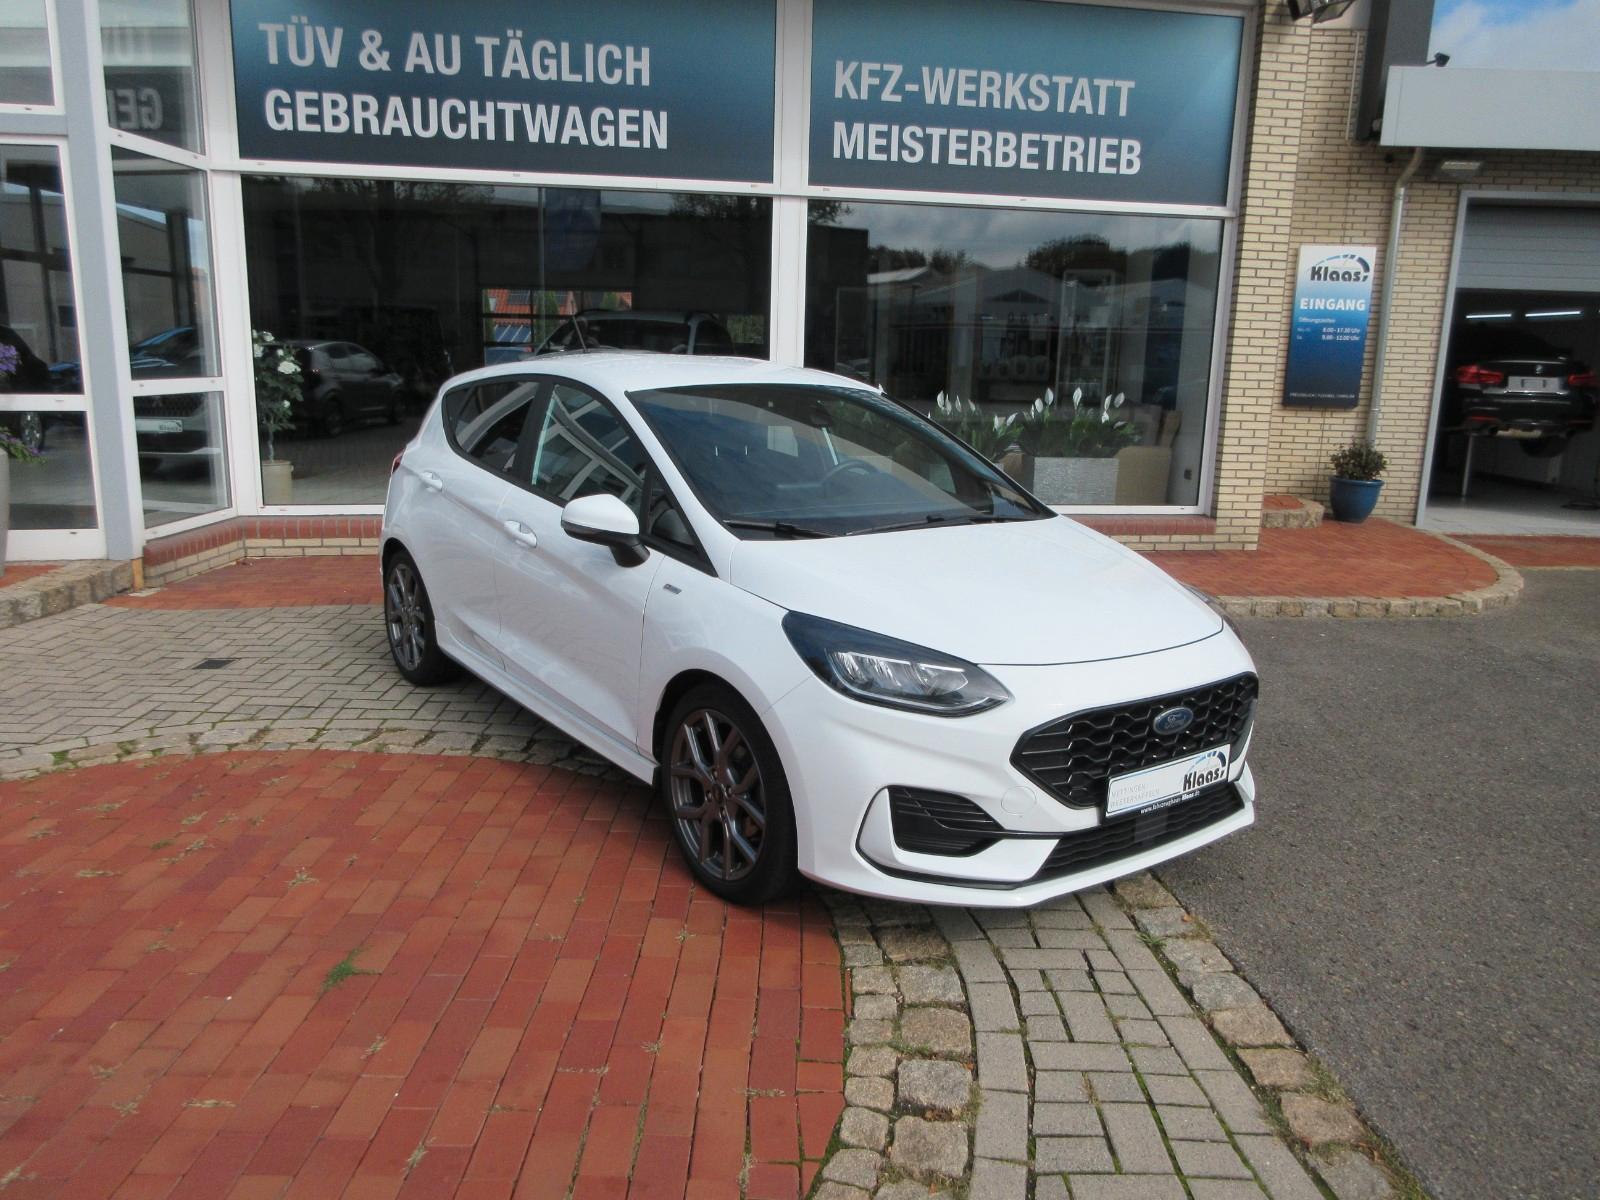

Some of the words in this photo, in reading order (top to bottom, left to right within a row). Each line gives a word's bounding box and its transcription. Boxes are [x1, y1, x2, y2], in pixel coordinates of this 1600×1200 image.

[259, 16, 343, 69] TÜV
[359, 30, 391, 71] &
[404, 33, 461, 76] AU
[475, 29, 650, 86] TÄGLICH
[834, 60, 1135, 117] KFZ-WERKSTATT
[265, 89, 668, 149] GEBRAUCHTWAGEN
[833, 121, 1141, 175] MEISTERBETRIEB
[1310, 266, 1361, 282] Klaas
[1300, 298, 1366, 311] EINGANG
[1183, 768, 1219, 791] Klaas
